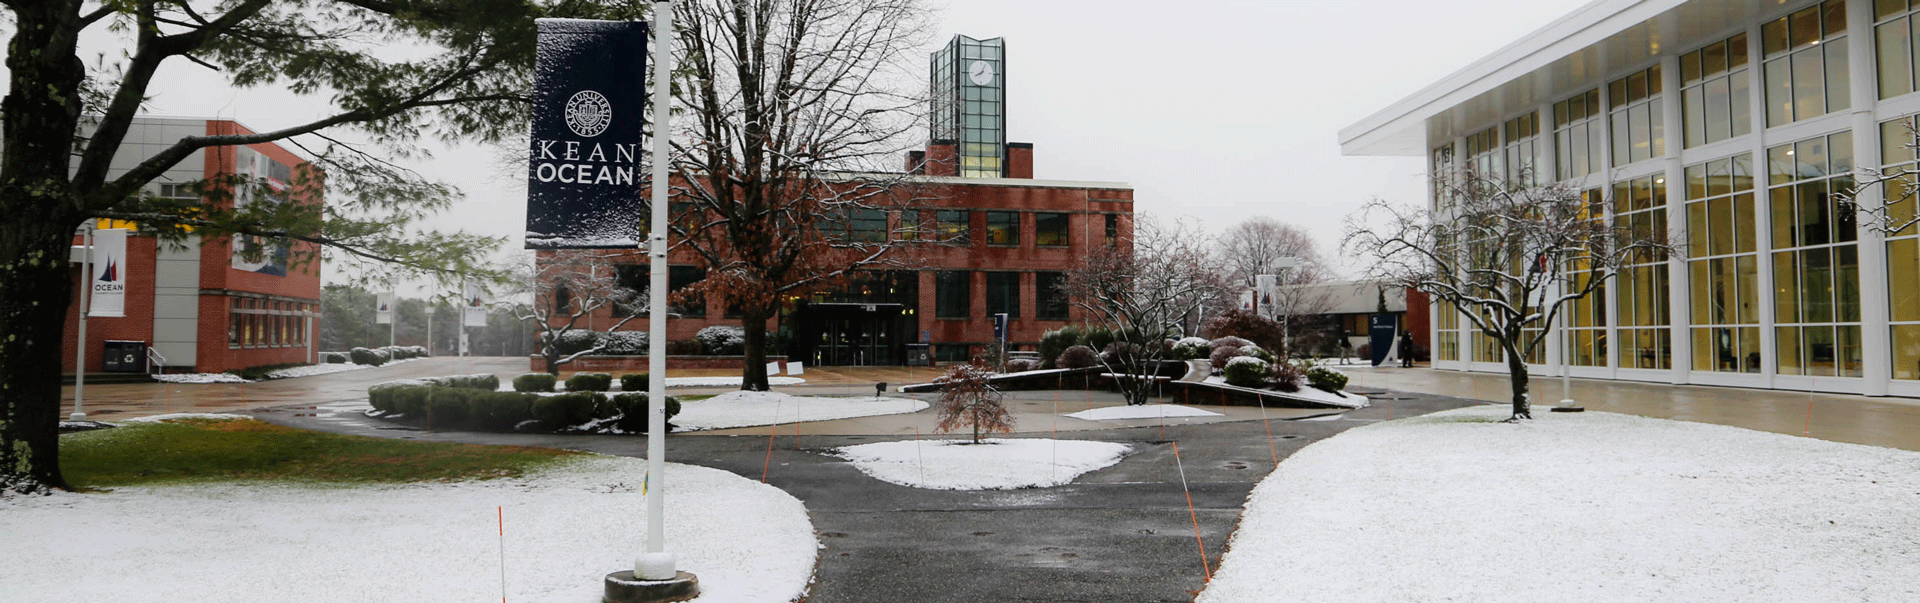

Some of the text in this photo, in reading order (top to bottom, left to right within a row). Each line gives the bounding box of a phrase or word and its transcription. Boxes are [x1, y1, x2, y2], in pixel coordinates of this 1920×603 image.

[566, 91, 610, 129] KEAN UNIVERSITY
[575, 126, 600, 136] 1855
[539, 140, 636, 163] KEAN
[536, 162, 634, 186] OCEAN
